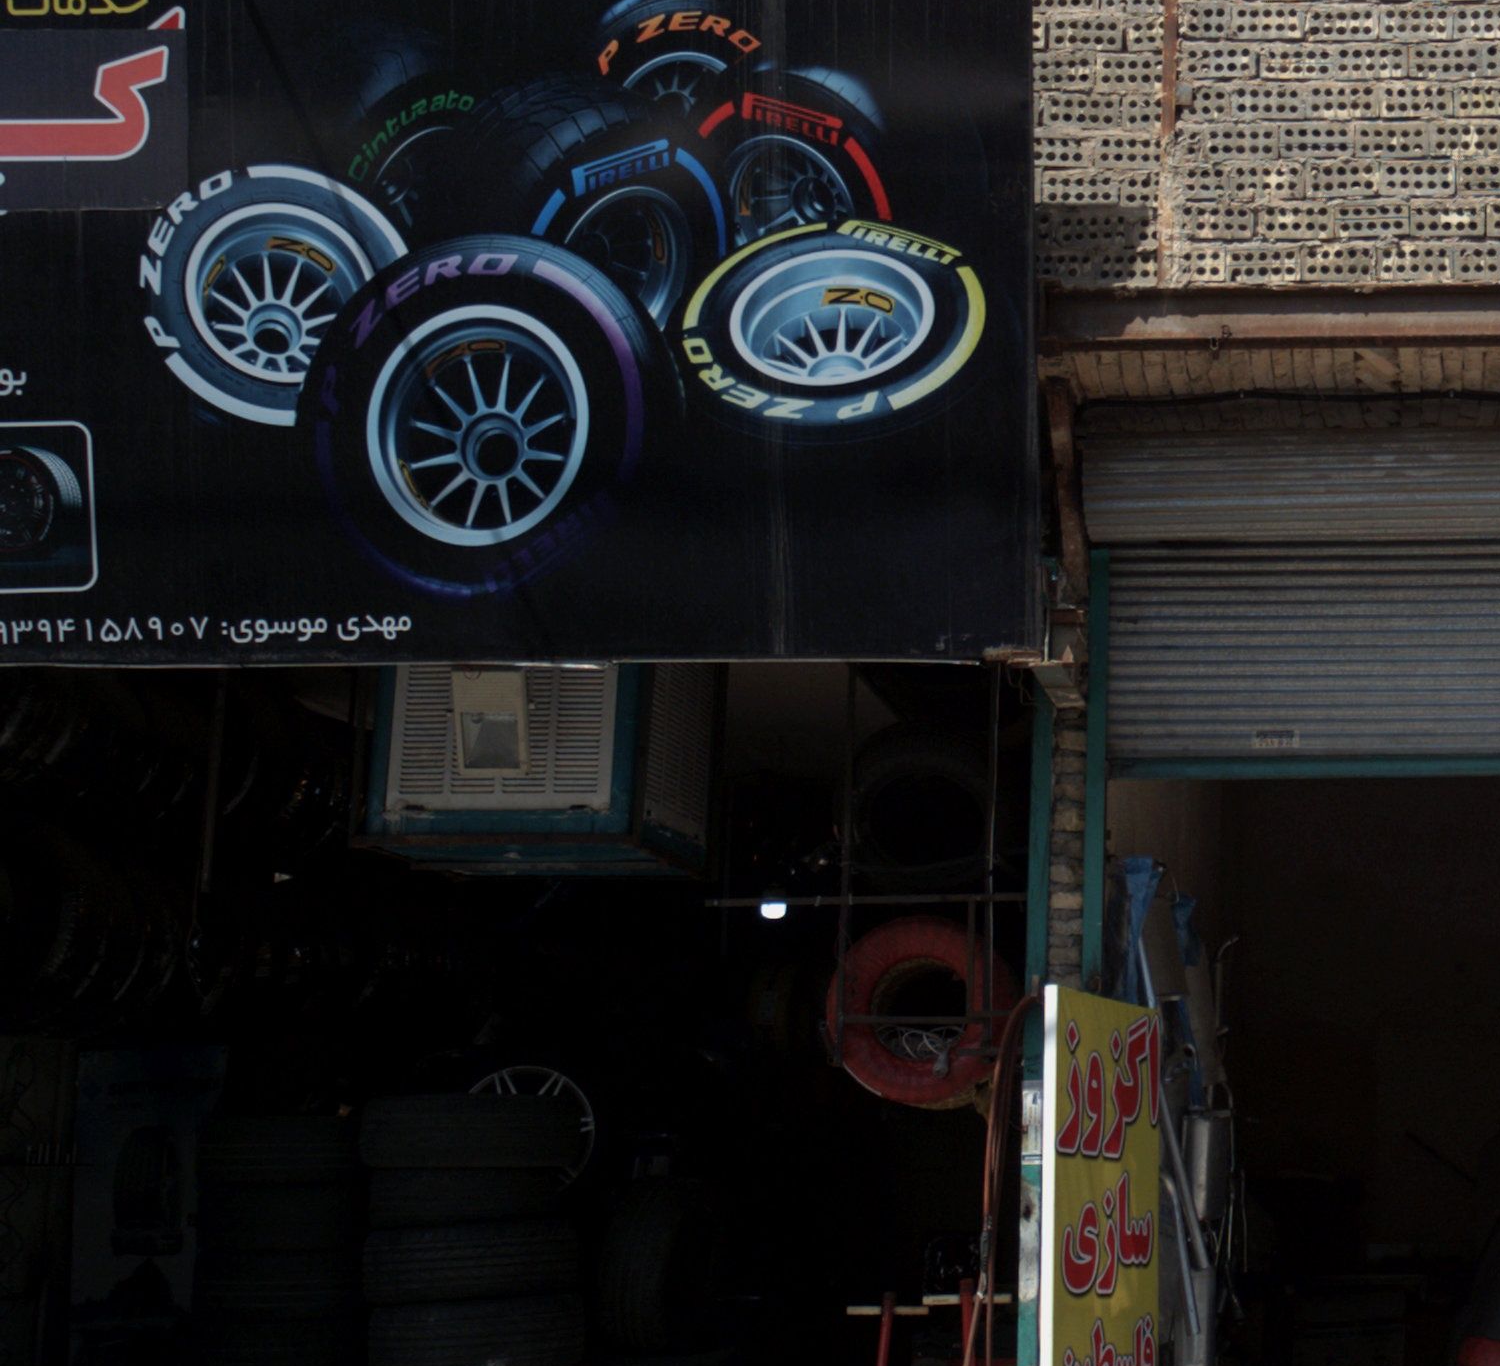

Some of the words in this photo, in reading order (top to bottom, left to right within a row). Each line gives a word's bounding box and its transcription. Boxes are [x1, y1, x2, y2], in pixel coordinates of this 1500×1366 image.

[635, 10, 762, 54] ZERO
[741, 91, 843, 146] PIRELLI
[571, 138, 670, 198] PIRELLI
[139, 169, 233, 296] ZERO
[836, 219, 963, 266] PIRELLI
[350, 252, 519, 349] ZERO
[682, 337, 815, 419] ZERO
[336, 614, 412, 641] مهدی
[1055, 1013, 1163, 1161] اگزوز
[1061, 1171, 1155, 1296] سازی
